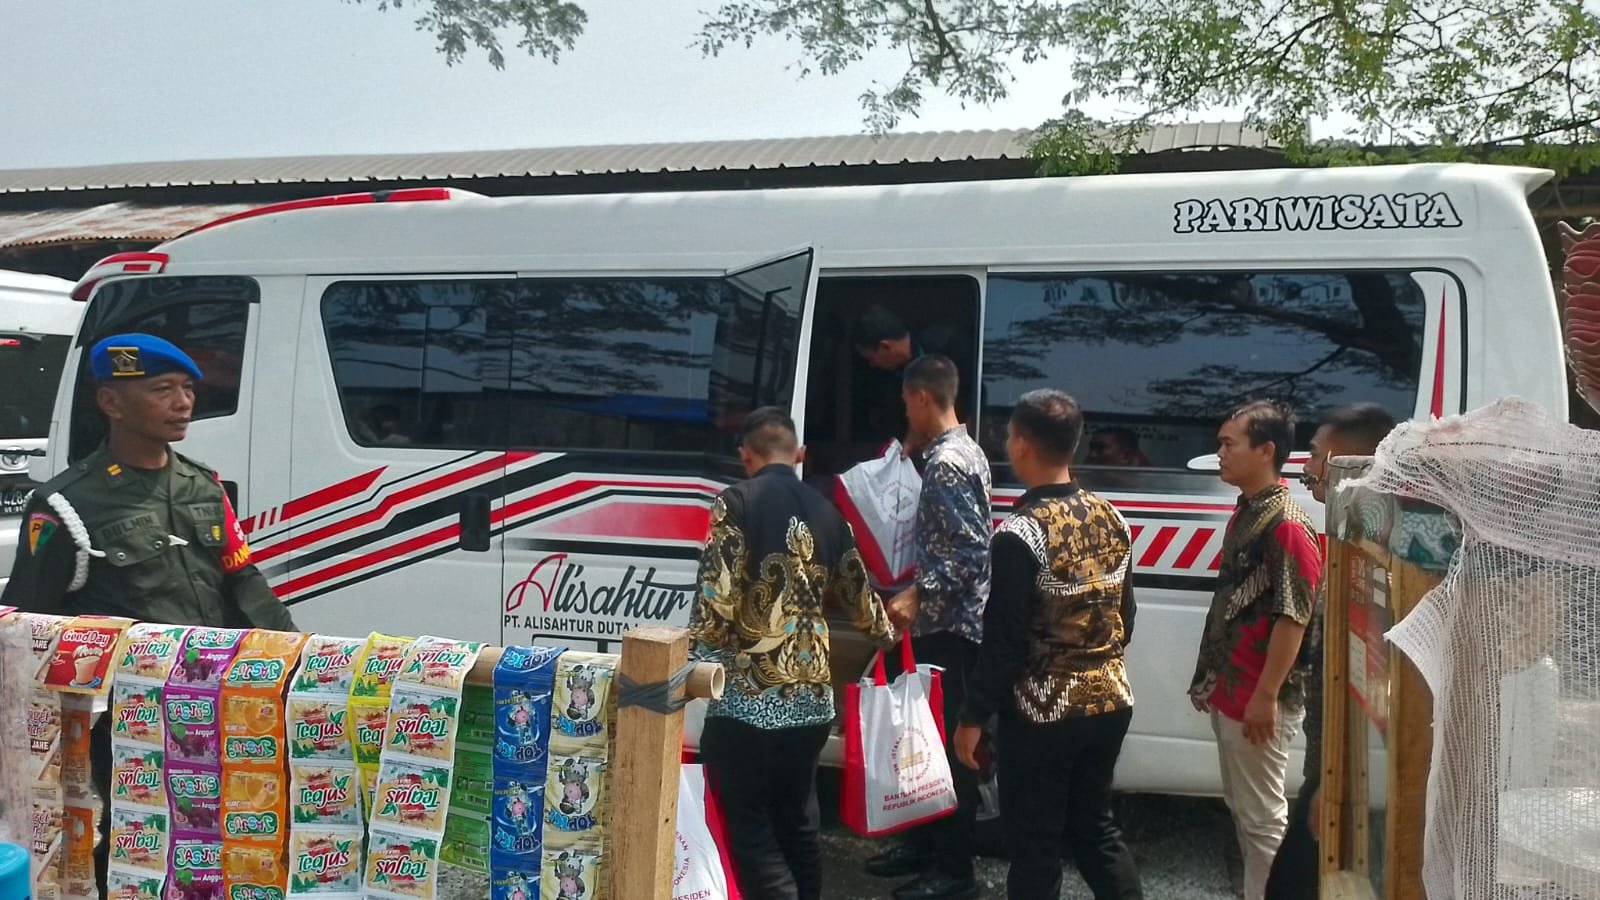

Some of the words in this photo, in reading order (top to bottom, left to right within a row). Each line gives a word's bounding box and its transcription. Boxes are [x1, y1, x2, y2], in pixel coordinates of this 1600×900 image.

[1174, 192, 1463, 234] PARIWISATA
[506, 553, 697, 620] Alisahtur
[504, 614, 520, 628] PT.
[524, 616, 593, 633] ALISAHTUR
[598, 621, 630, 635] DUTA
[127, 641, 172, 659] Teajus
[414, 649, 467, 667] Teajus
[305, 652, 352, 673] Teajus
[365, 657, 404, 678] Teaju
[120, 702, 160, 724] Teajus
[296, 721, 344, 743] Teajus
[358, 726, 385, 747] Teaj
[395, 714, 449, 738] Teajus
[118, 767, 160, 788] Teajus
[202, 802, 220, 810] Anggu
[300, 787, 347, 809] Teajus
[385, 783, 440, 808] Teajus
[116, 830, 161, 851] Teajus
[299, 851, 350, 875] Teajus
[375, 855, 429, 880] Teajus
[202, 874, 224, 883] Anggu
